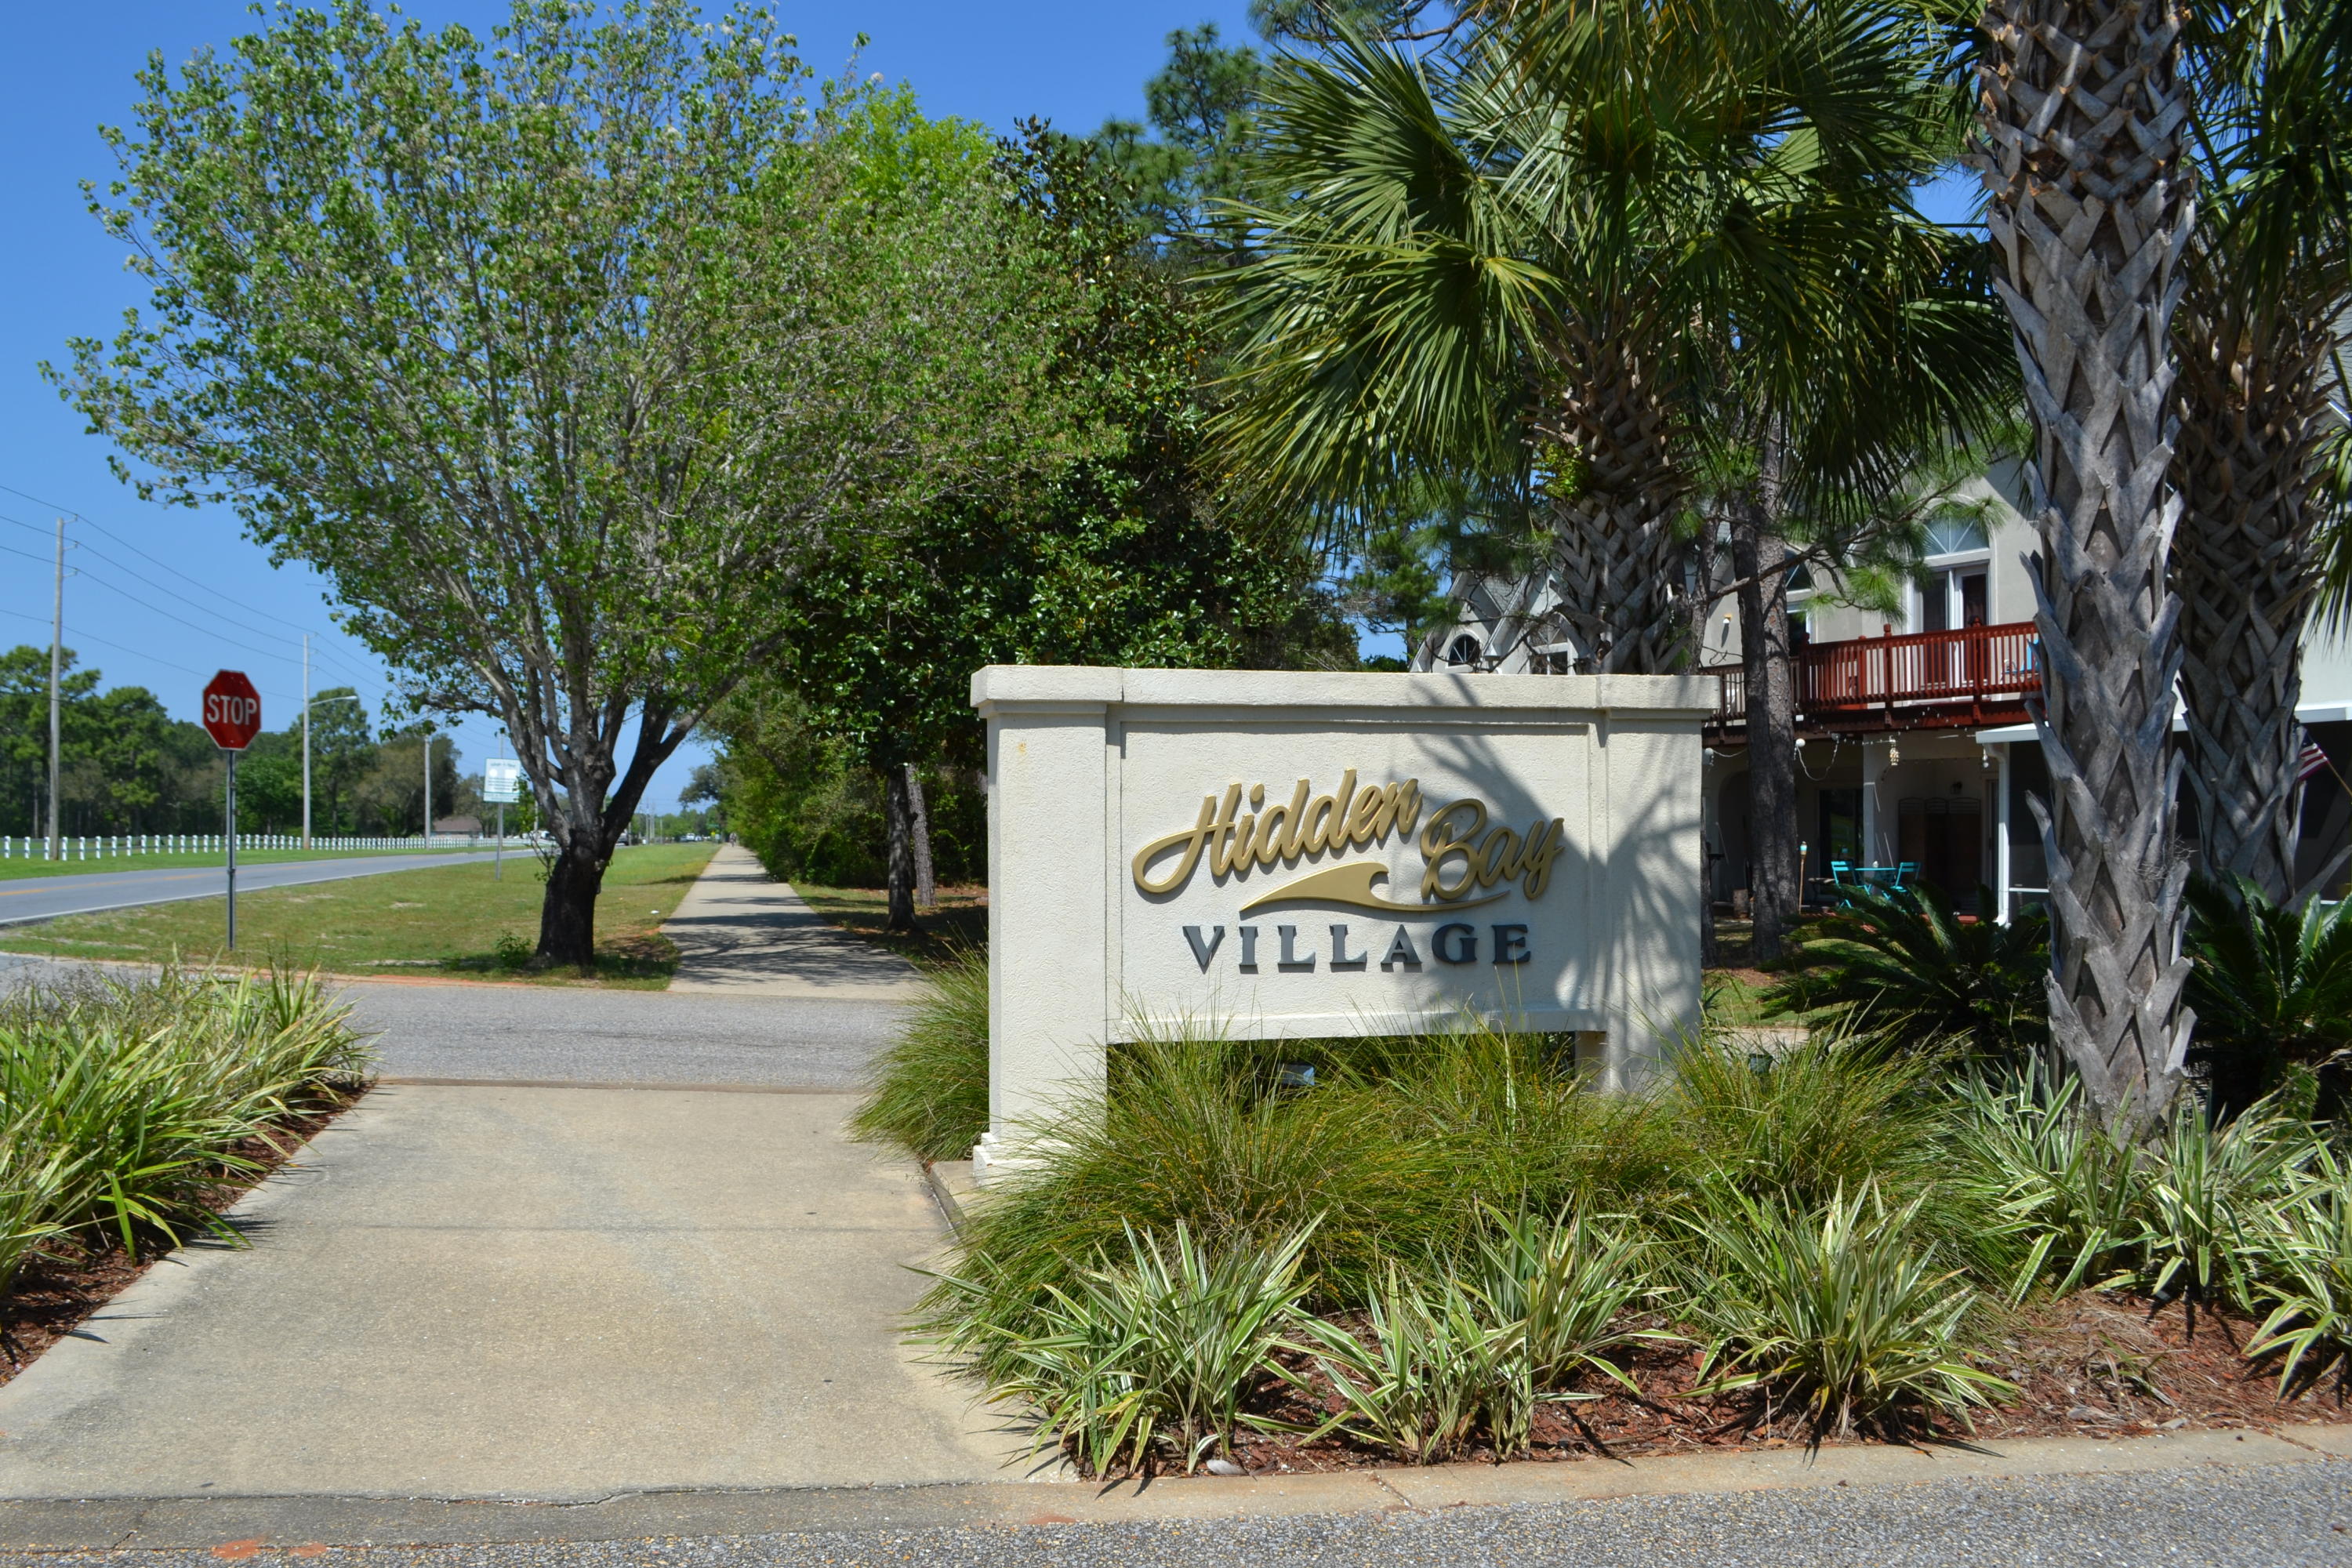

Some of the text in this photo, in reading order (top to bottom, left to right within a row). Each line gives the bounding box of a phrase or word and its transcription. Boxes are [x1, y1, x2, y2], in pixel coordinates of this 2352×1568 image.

[206, 694, 258, 725] STOP
[1131, 768, 1565, 900] Hidden Bay
[1182, 923, 1531, 972] VILLAGE
